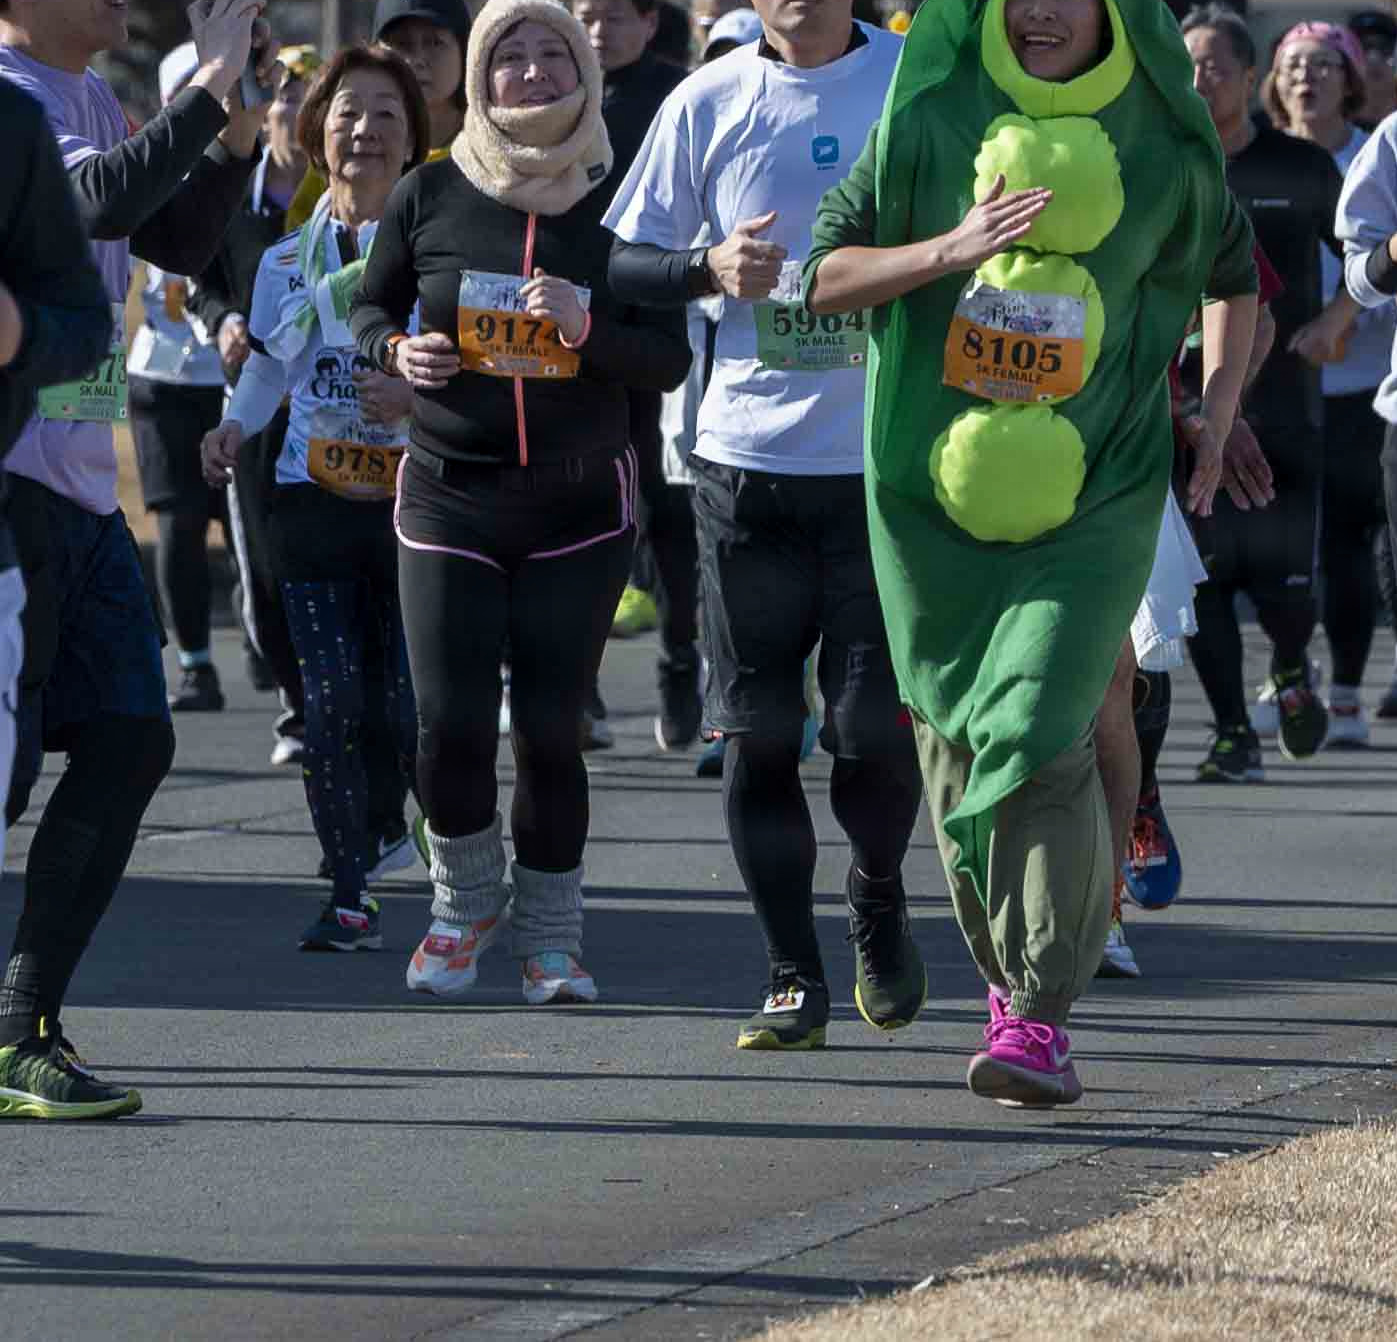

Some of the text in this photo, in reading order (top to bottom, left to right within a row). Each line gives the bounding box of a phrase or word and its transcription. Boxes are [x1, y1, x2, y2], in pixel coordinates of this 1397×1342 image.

[812, 335, 848, 347] MALE
[962, 328, 1062, 372] 8105
[992, 366, 1043, 385] FEMALE
[311, 377, 358, 399] Cha
